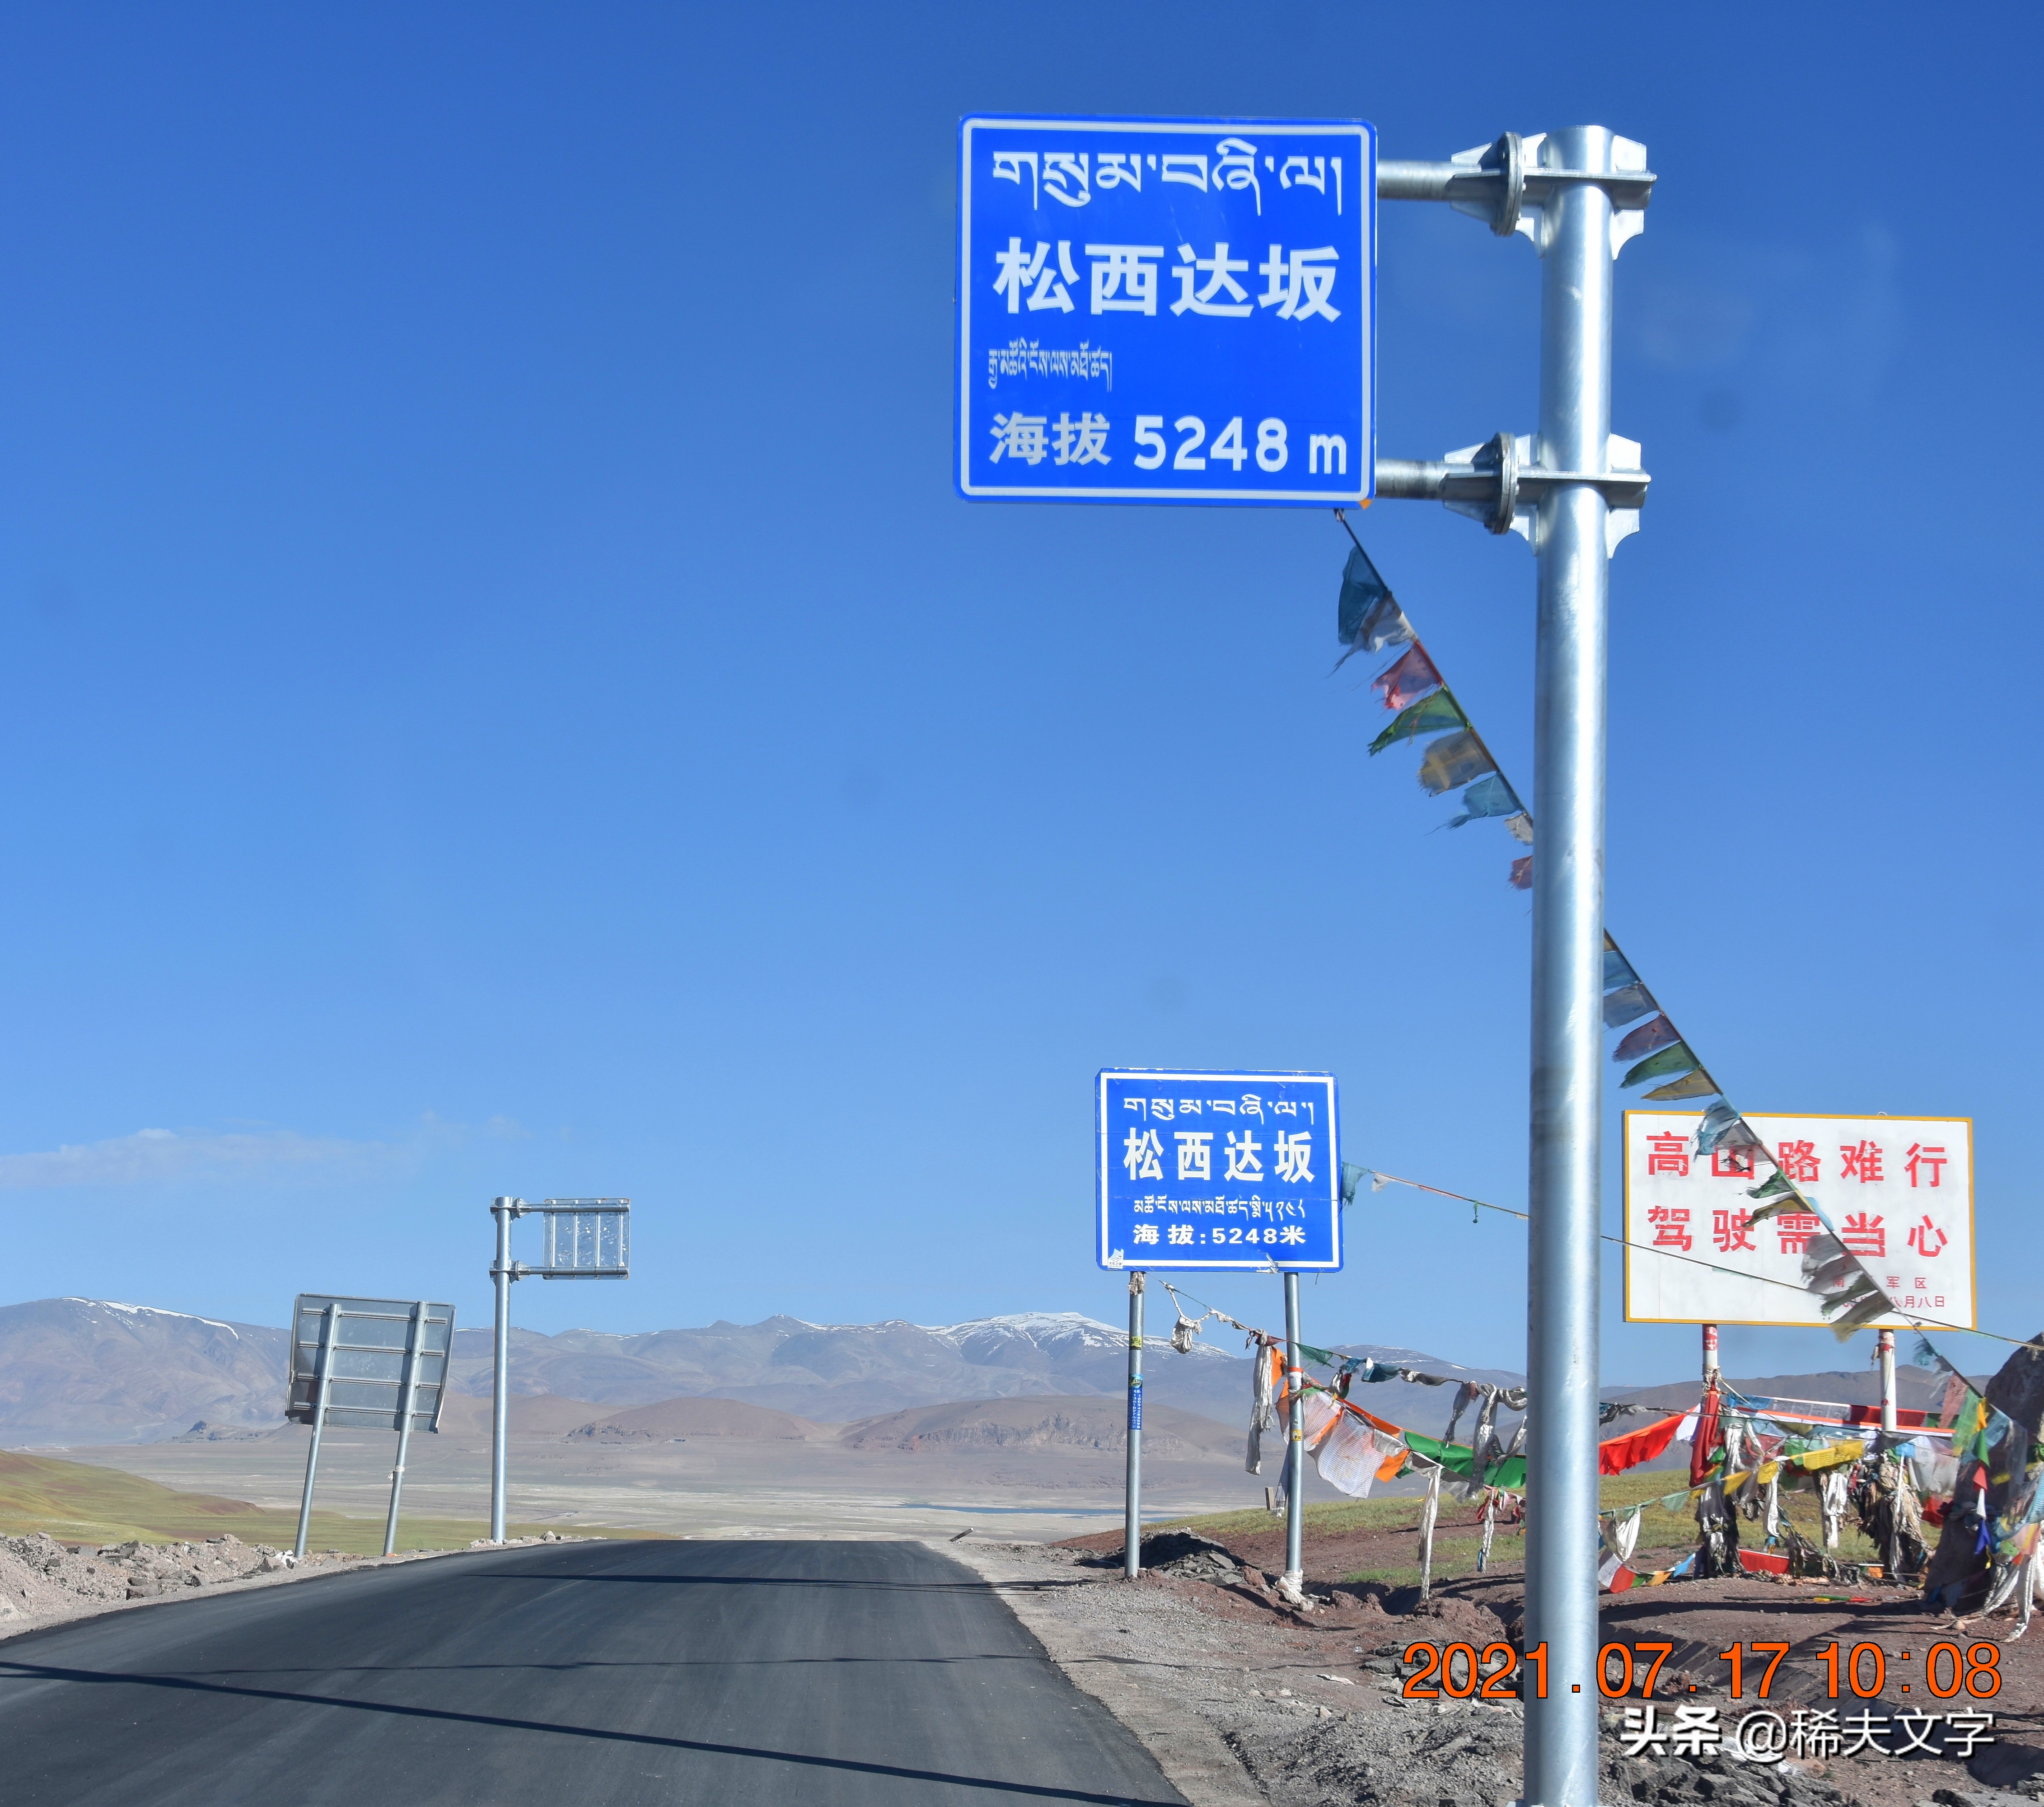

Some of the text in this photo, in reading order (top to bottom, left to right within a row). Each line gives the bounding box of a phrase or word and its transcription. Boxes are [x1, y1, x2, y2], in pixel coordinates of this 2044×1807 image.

[992, 236, 1342, 323] 松西达坂
[989, 412, 1347, 474] 海拔 5248 m
[1123, 1127, 1315, 1184] 松西达坂
[1646, 1131, 1948, 1188] 高山路难行
[1647, 1205, 1948, 1258] 驾驶需当心
